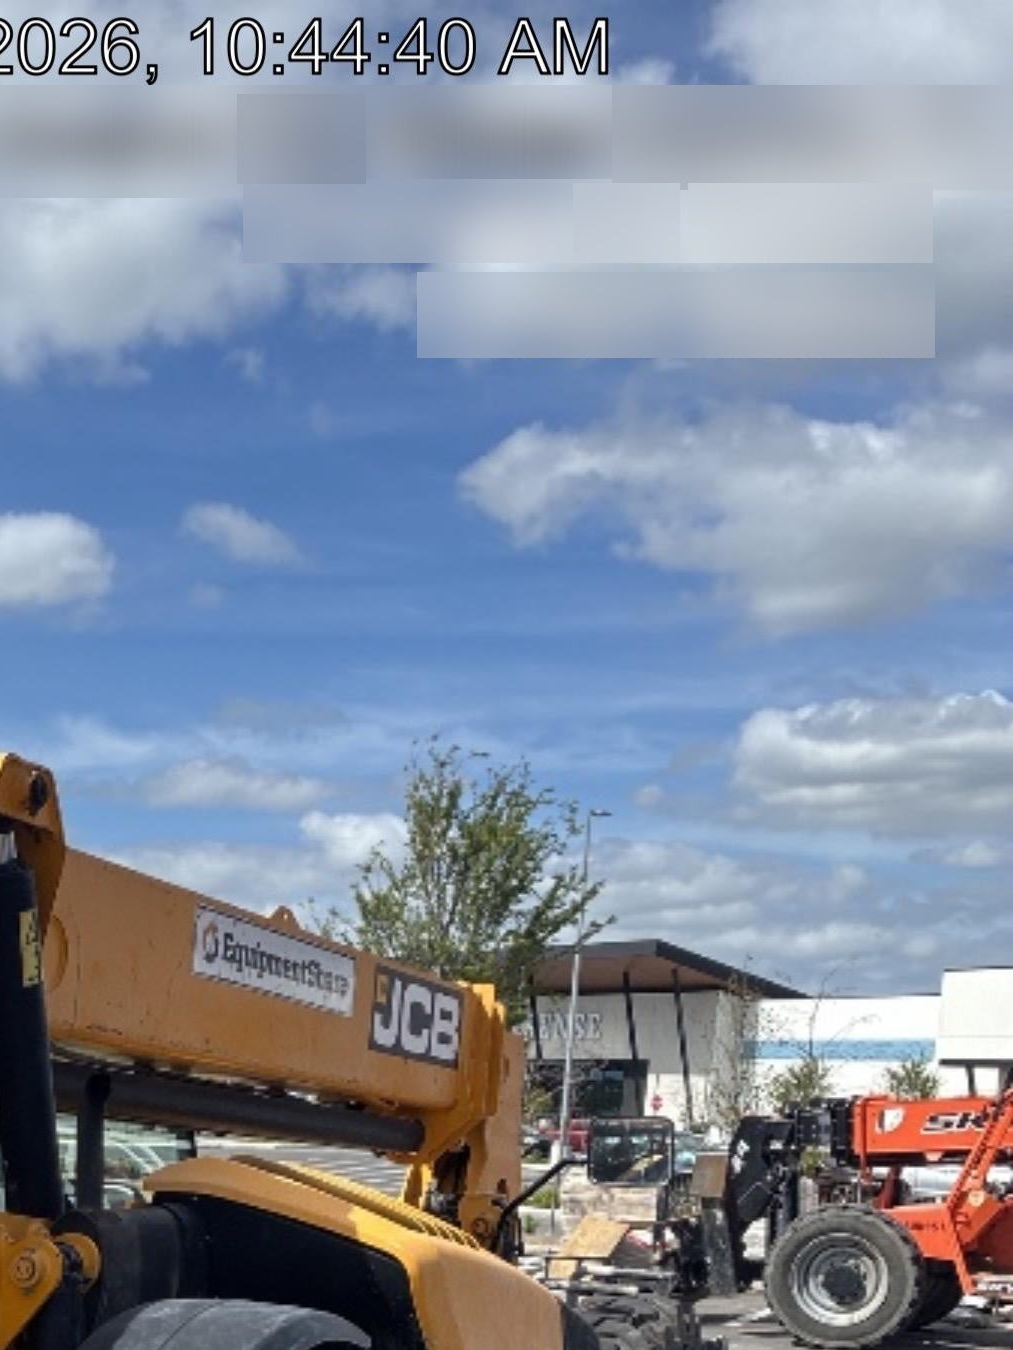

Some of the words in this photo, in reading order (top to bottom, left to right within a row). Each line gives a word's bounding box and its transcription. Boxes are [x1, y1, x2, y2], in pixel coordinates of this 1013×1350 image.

[223, 932, 349, 997] EquipmentShare
[373, 975, 461, 1061] JCB
[920, 1111, 990, 1135] SK
